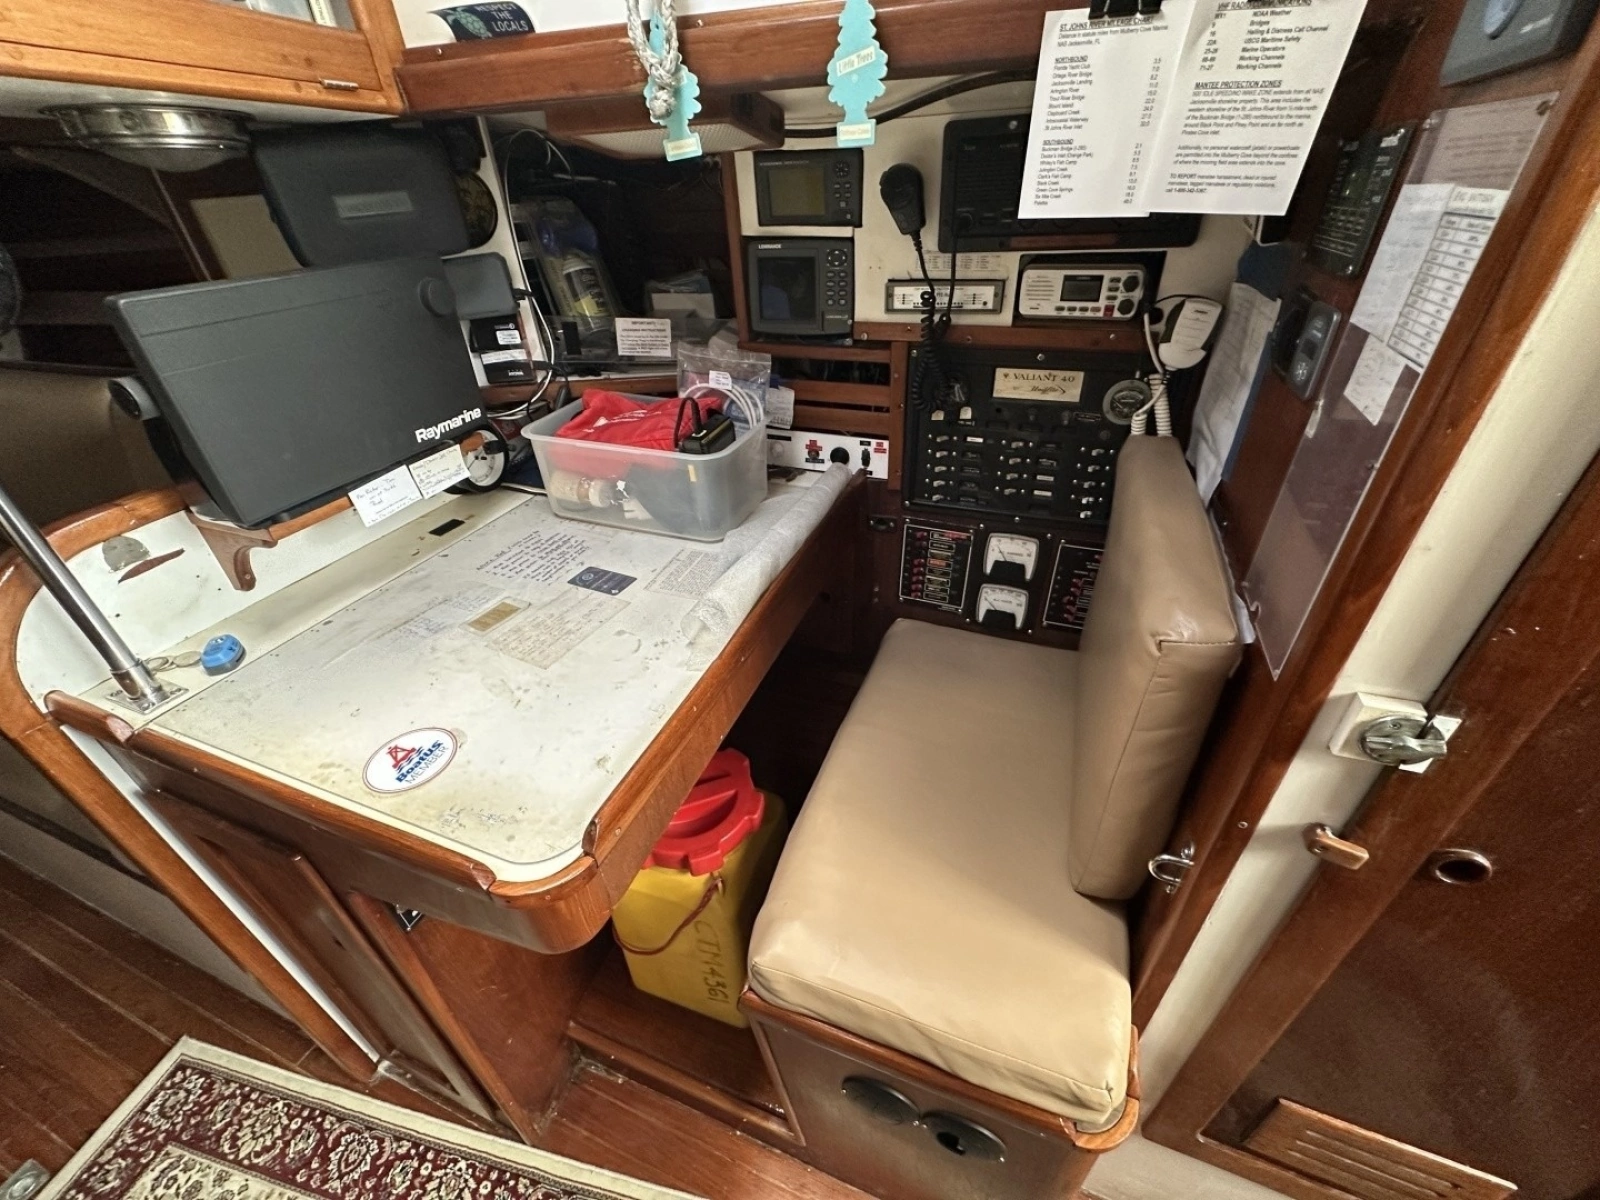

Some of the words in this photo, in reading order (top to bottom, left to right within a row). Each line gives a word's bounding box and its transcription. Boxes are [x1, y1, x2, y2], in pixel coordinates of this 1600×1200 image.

[475, 3, 518, 12] RESPECT
[492, 11, 511, 19] THE
[492, 20, 528, 31] LOCALS
[1069, 22, 1088, 31] JOHNS
[838, 58, 855, 74] Little
[856, 51, 873, 66] Trees
[1054, 55, 1088, 64] NORTHBOUND
[1194, 82, 1220, 90] MANTEE
[1220, 80, 1260, 90] PROTECTION
[1260, 80, 1283, 88] ZONES
[1071, 94, 1085, 102] Bridge
[1013, 372, 1058, 382] VALIANT
[1061, 375, 1075, 383] 40
[414, 407, 482, 443] Raymarine
[405, 746, 449, 784] MEMBER
